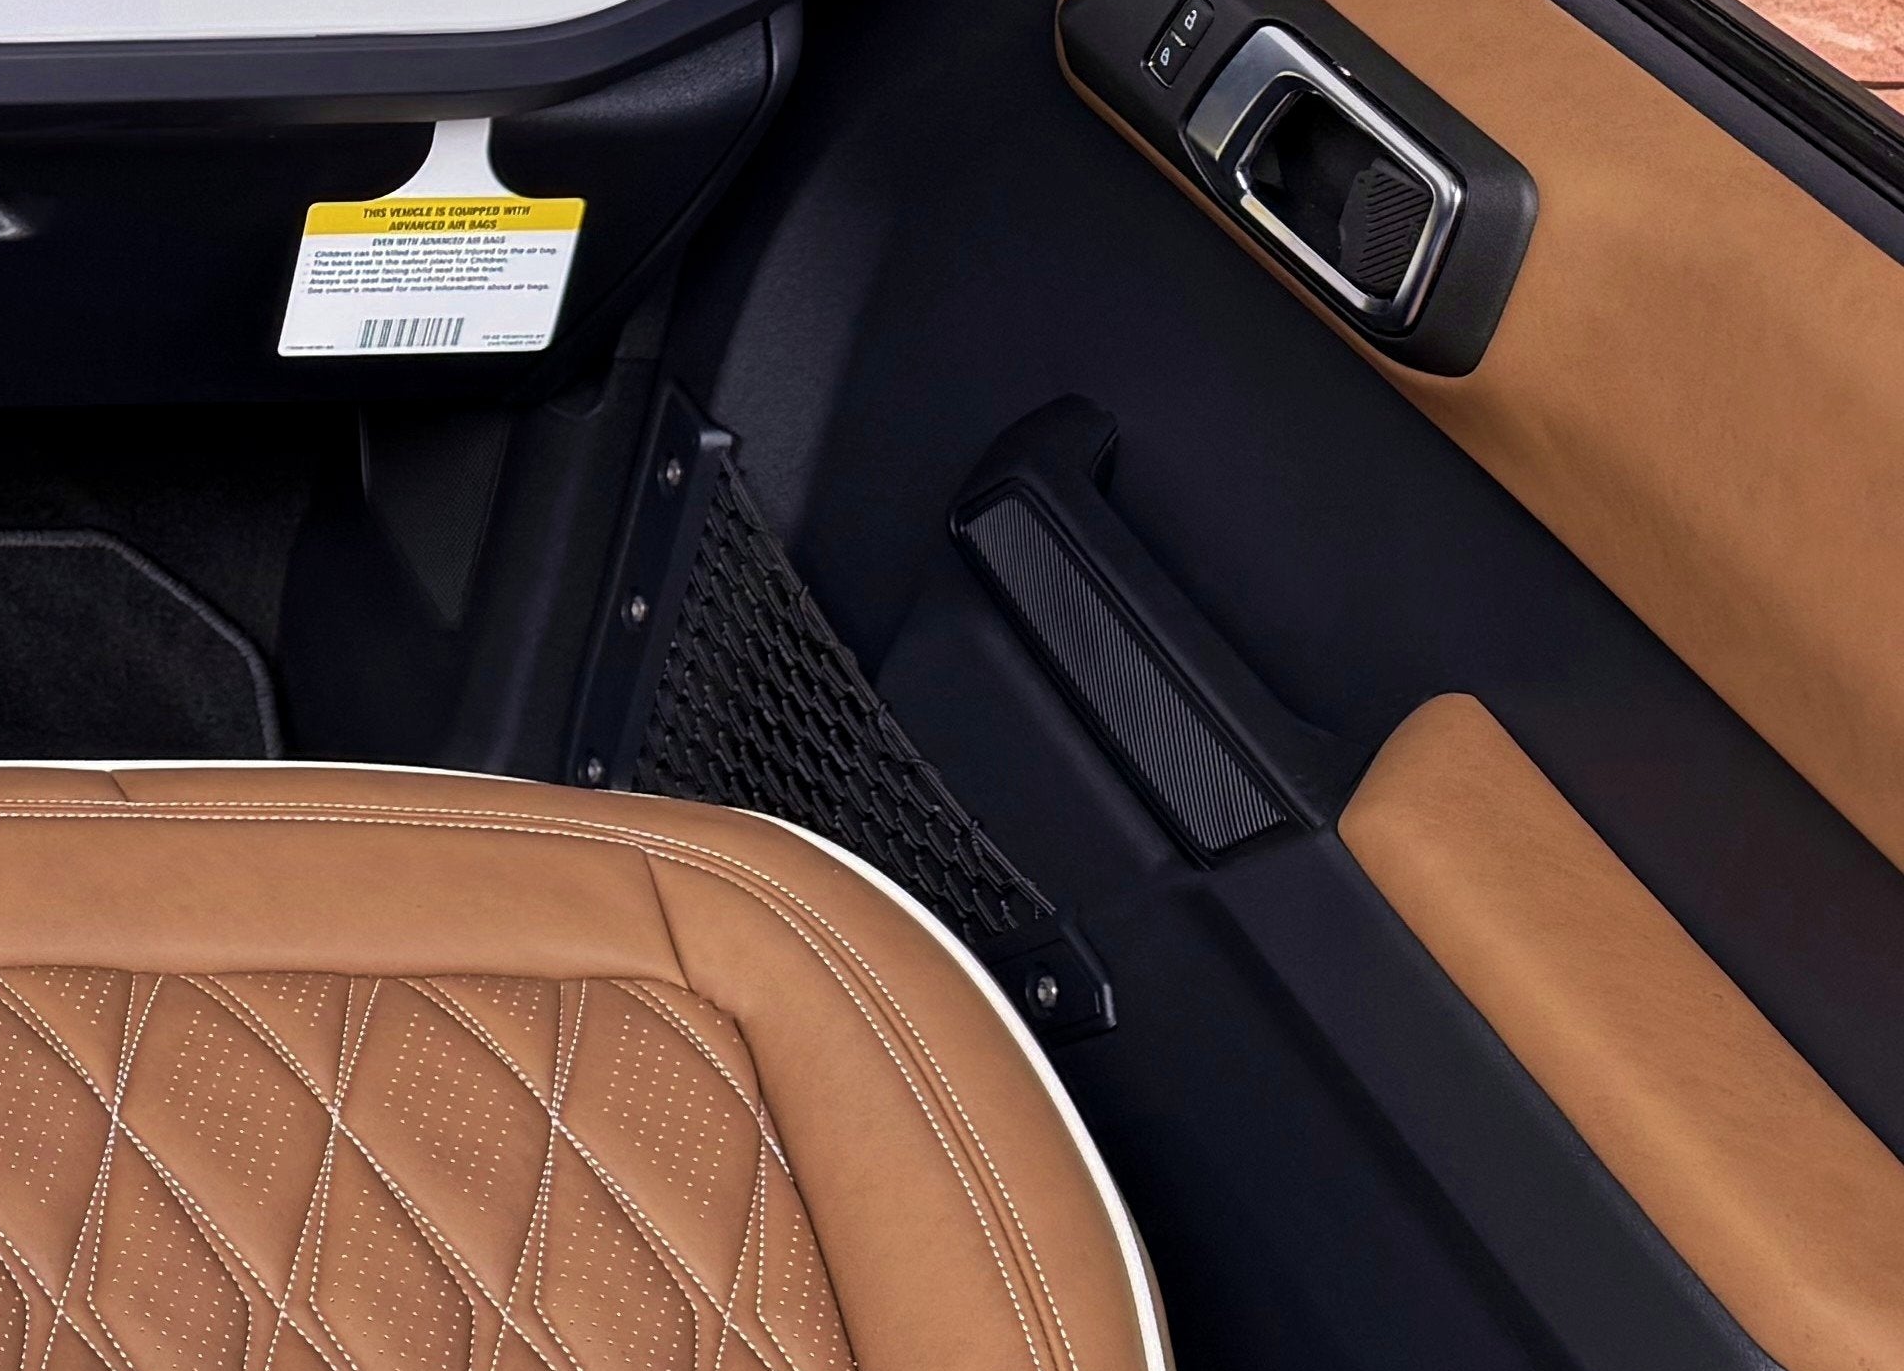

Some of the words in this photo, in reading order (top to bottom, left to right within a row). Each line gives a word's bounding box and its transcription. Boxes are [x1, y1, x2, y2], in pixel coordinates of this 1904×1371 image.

[364, 208, 387, 218] THIS
[390, 207, 433, 218] VEHICLE
[435, 207, 446, 217] IS
[448, 207, 500, 217] EQUIPPED
[503, 206, 531, 216] WITH
[388, 221, 445, 231] ADVANCED
[448, 221, 466, 230] AIR
[469, 220, 497, 230] BAGS
[372, 238, 394, 246] EVEN
